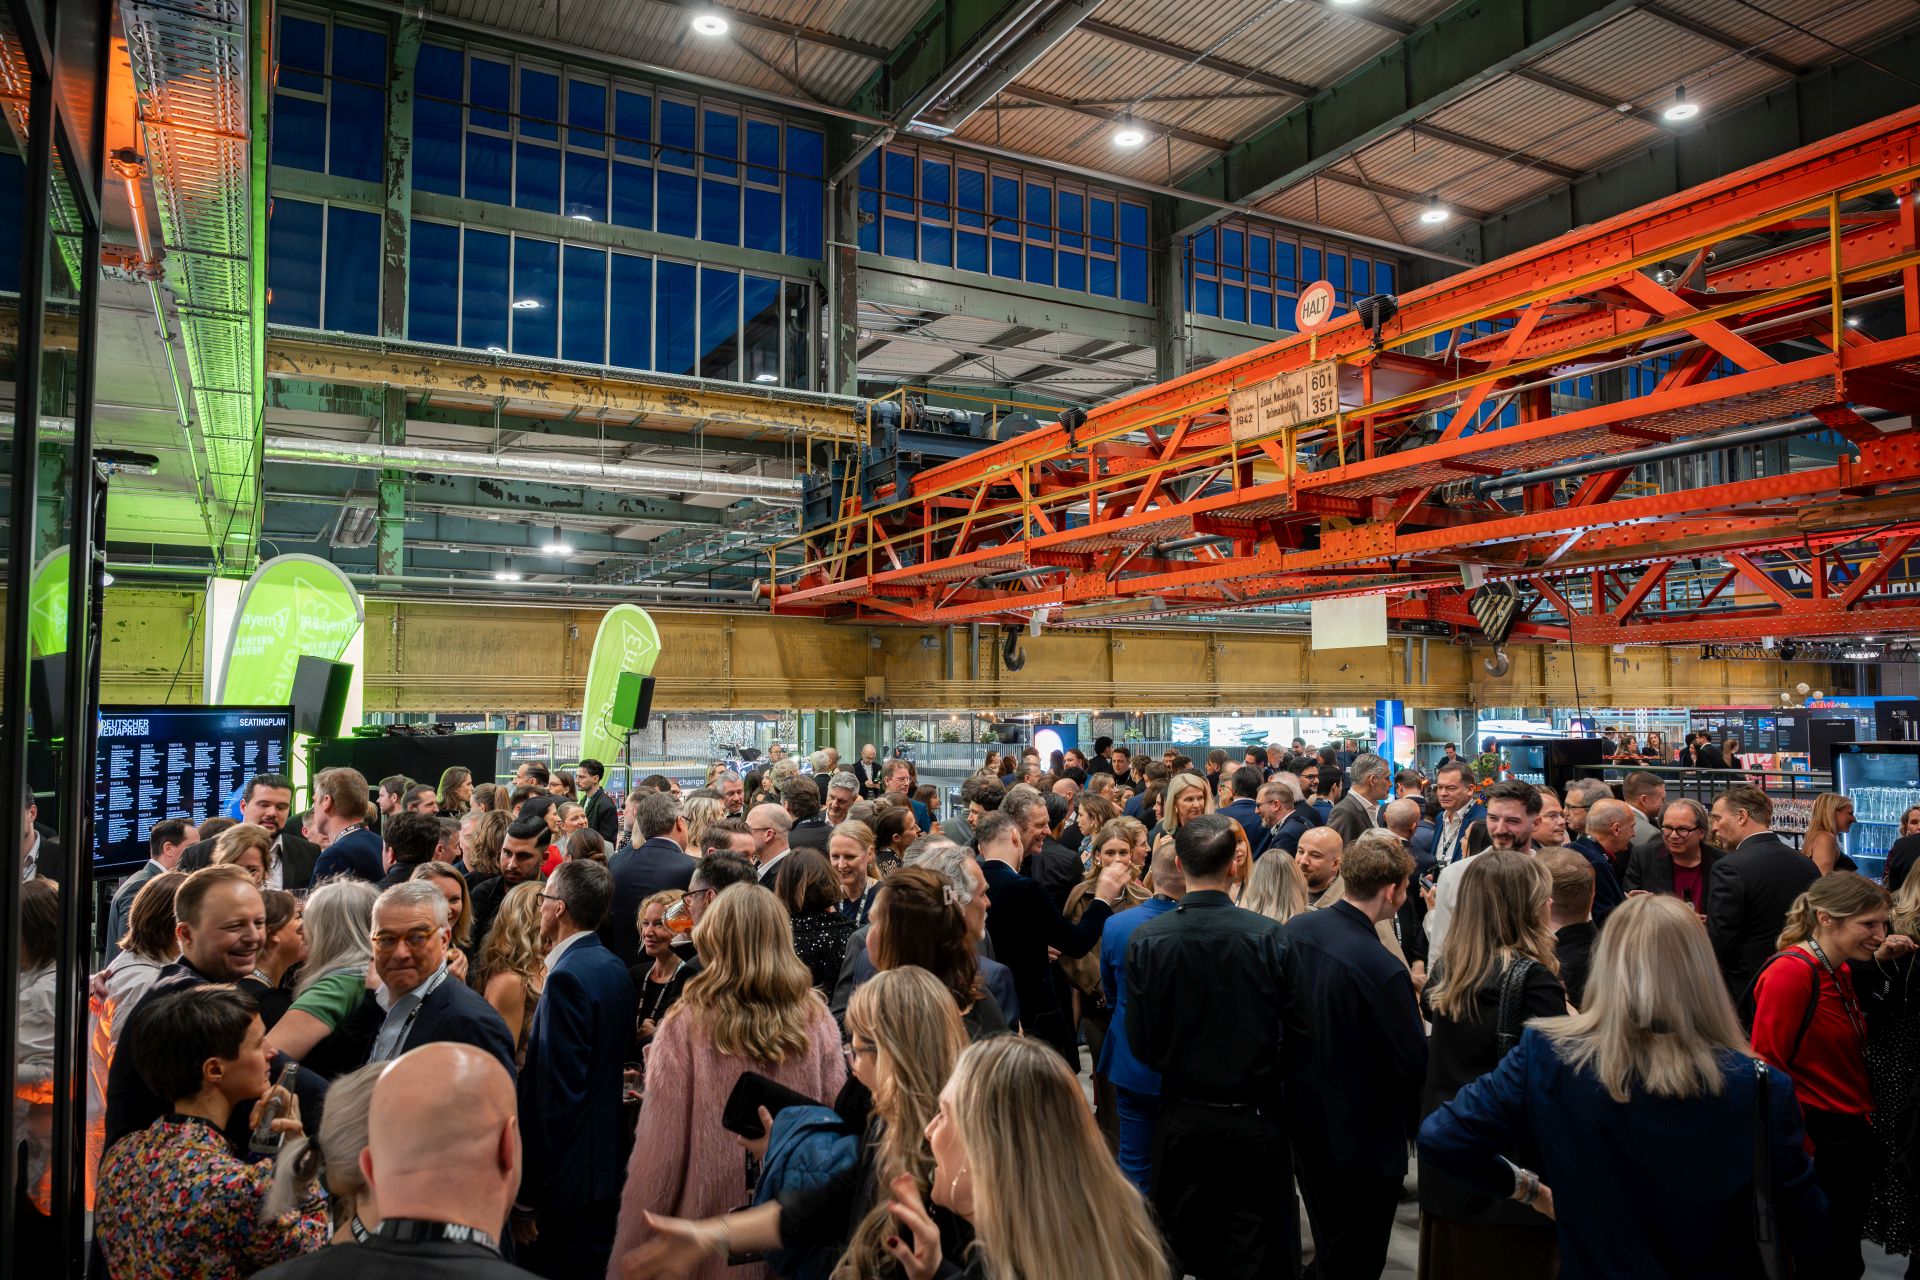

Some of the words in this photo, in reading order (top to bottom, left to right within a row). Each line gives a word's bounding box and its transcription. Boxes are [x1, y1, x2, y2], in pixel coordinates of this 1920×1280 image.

[1302, 294, 1328, 319] HALT
[1311, 374, 1326, 391] 60
[1327, 372, 1332, 387] t
[1312, 397, 1327, 415] 35
[1328, 396, 1333, 410] t
[1235, 413, 1253, 427] 1942
[240, 614, 274, 630] ayern
[627, 634, 642, 650] 3
[101, 719, 149, 729] DEUTSCHER
[239, 717, 286, 727] SEATINGPLAN
[678, 778, 705, 787] change
